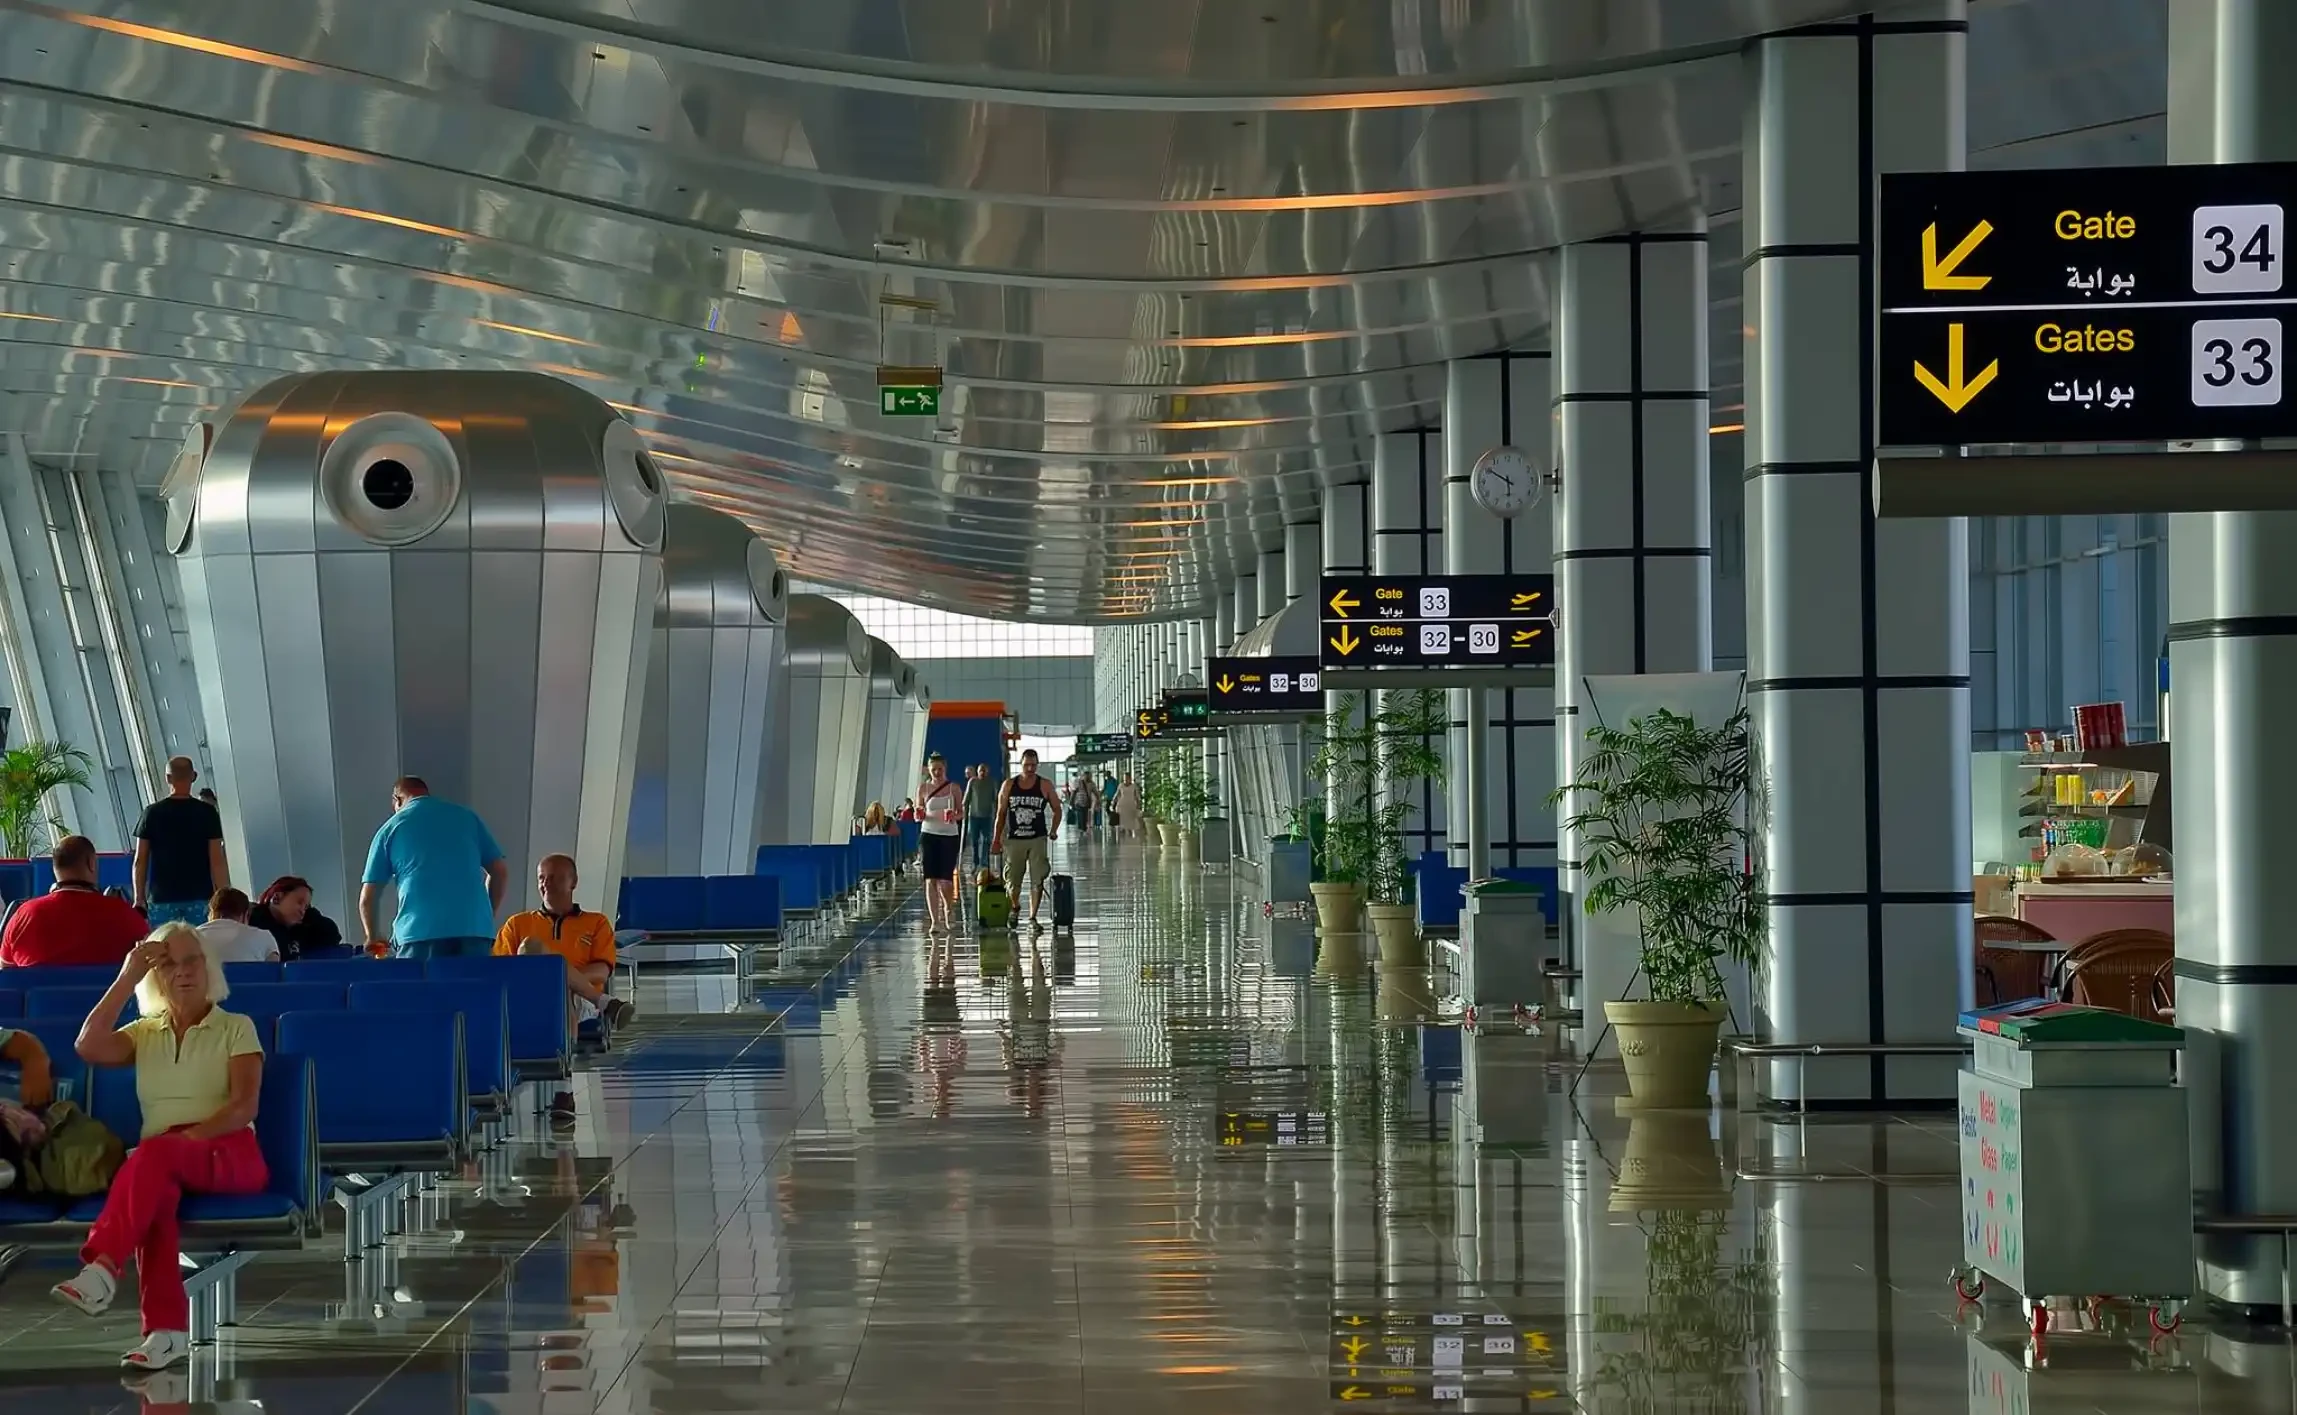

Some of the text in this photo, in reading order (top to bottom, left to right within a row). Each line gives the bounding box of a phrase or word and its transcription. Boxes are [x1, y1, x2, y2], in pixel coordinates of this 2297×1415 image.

[2055, 210, 2275, 274] Gate 34
[2066, 265, 2135, 296] بوابة
[2035, 323, 2274, 387] Gates 33
[2047, 379, 2134, 409] بوابات
[1375, 588, 1447, 612] Gate 33
[1379, 606, 1403, 618] بوابة
[1370, 625, 1403, 636] Gates
[1423, 631, 1447, 647] 32
[1473, 631, 1496, 647] 30
[1374, 643, 1404, 655] بوابات
[1272, 678, 1287, 688] 32
[1301, 678, 1316, 688] 30
[1961, 1105, 1977, 1138] Plastic
[1979, 1089, 1996, 1125] Metal
[1981, 1136, 1997, 1171] Glass
[2001, 1143, 2017, 1177] Paper
